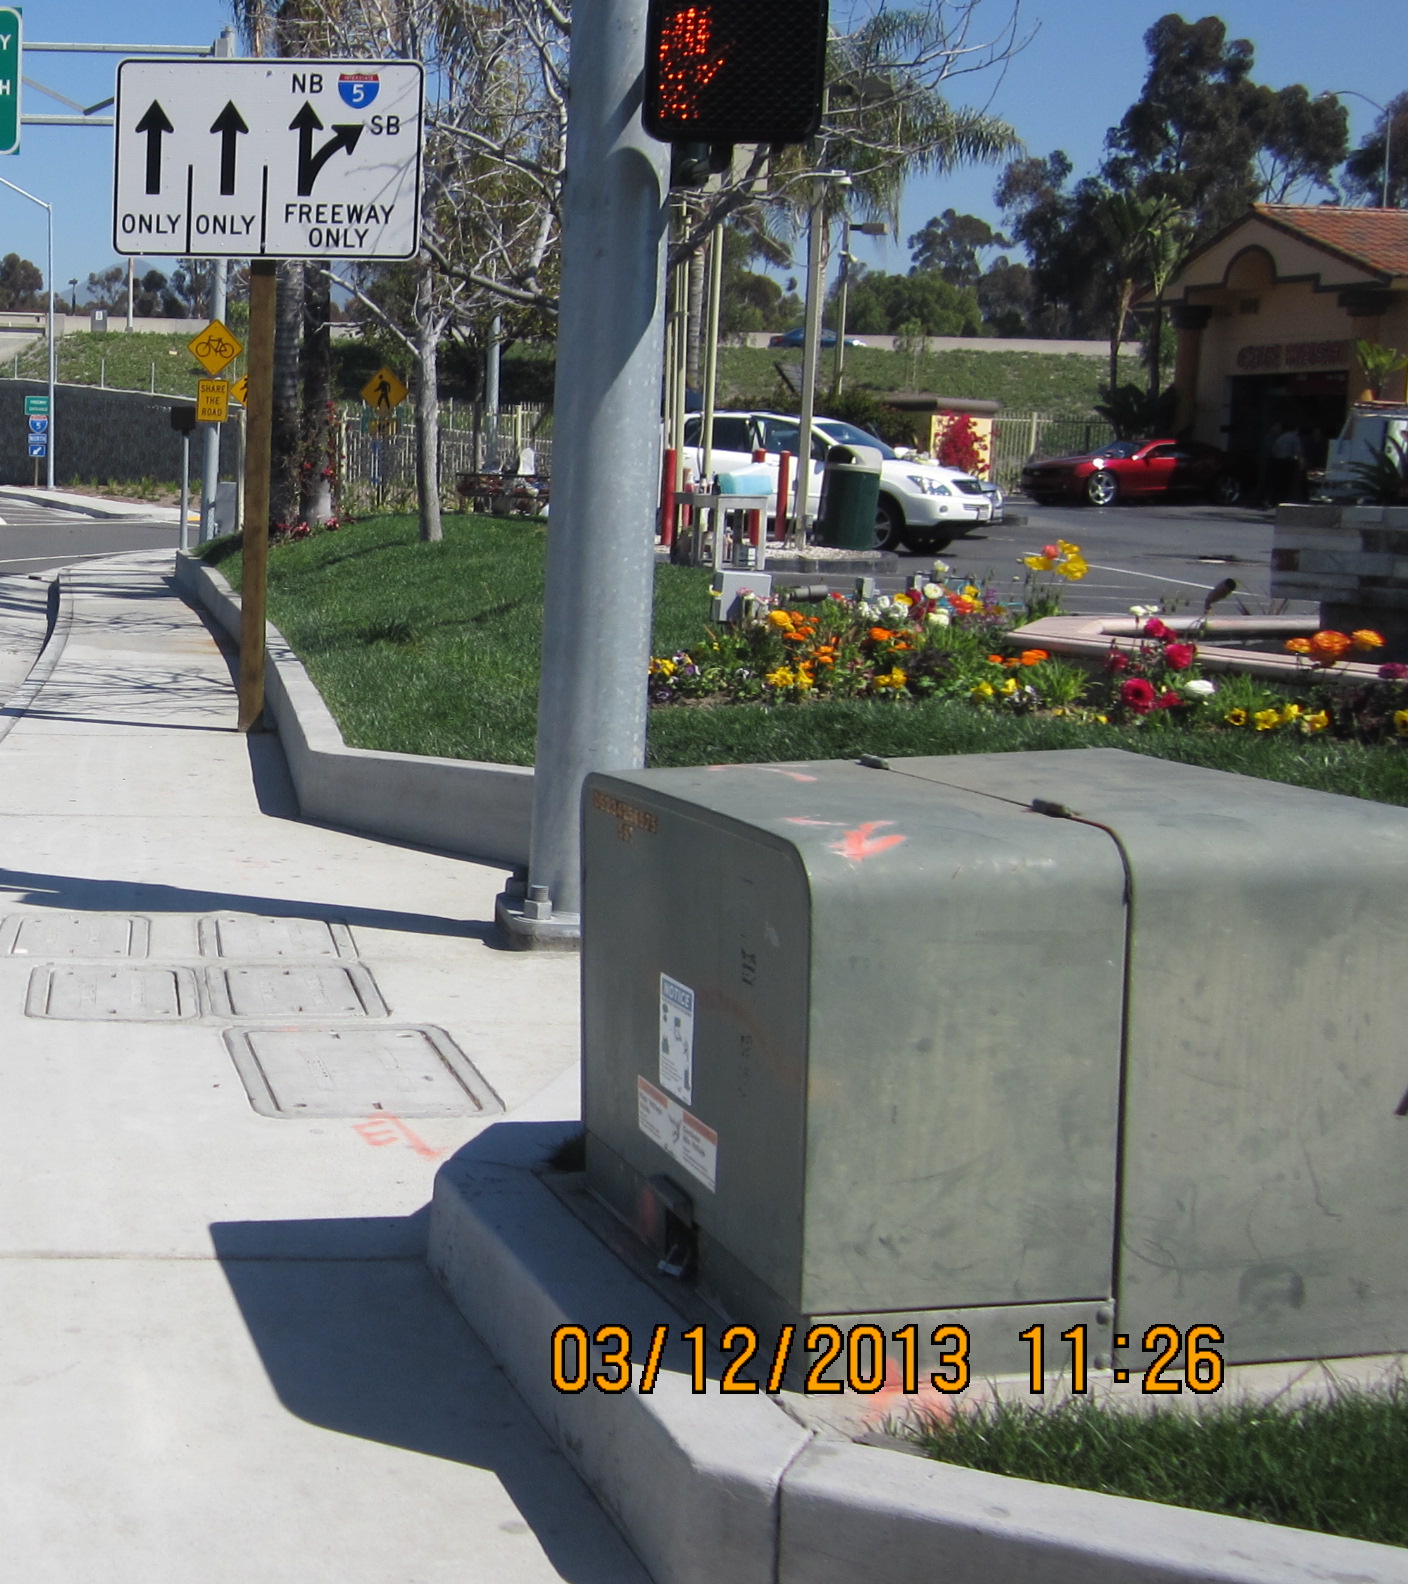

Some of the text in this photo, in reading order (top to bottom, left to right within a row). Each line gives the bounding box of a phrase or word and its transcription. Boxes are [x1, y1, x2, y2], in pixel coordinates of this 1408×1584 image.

[292, 73, 323, 94] NB
[352, 83, 365, 103] 5
[370, 115, 401, 136] SB
[122, 213, 182, 235] ONLY
[284, 203, 395, 225] FREEWAY
[195, 214, 256, 236] ONLY
[308, 228, 369, 249] ONLY
[201, 384, 226, 394] SHARE
[205, 395, 220, 405] THE
[202, 407, 223, 417] ROAD
[35, 421, 42, 430] 5
[663, 979, 691, 1009] NOTICE
